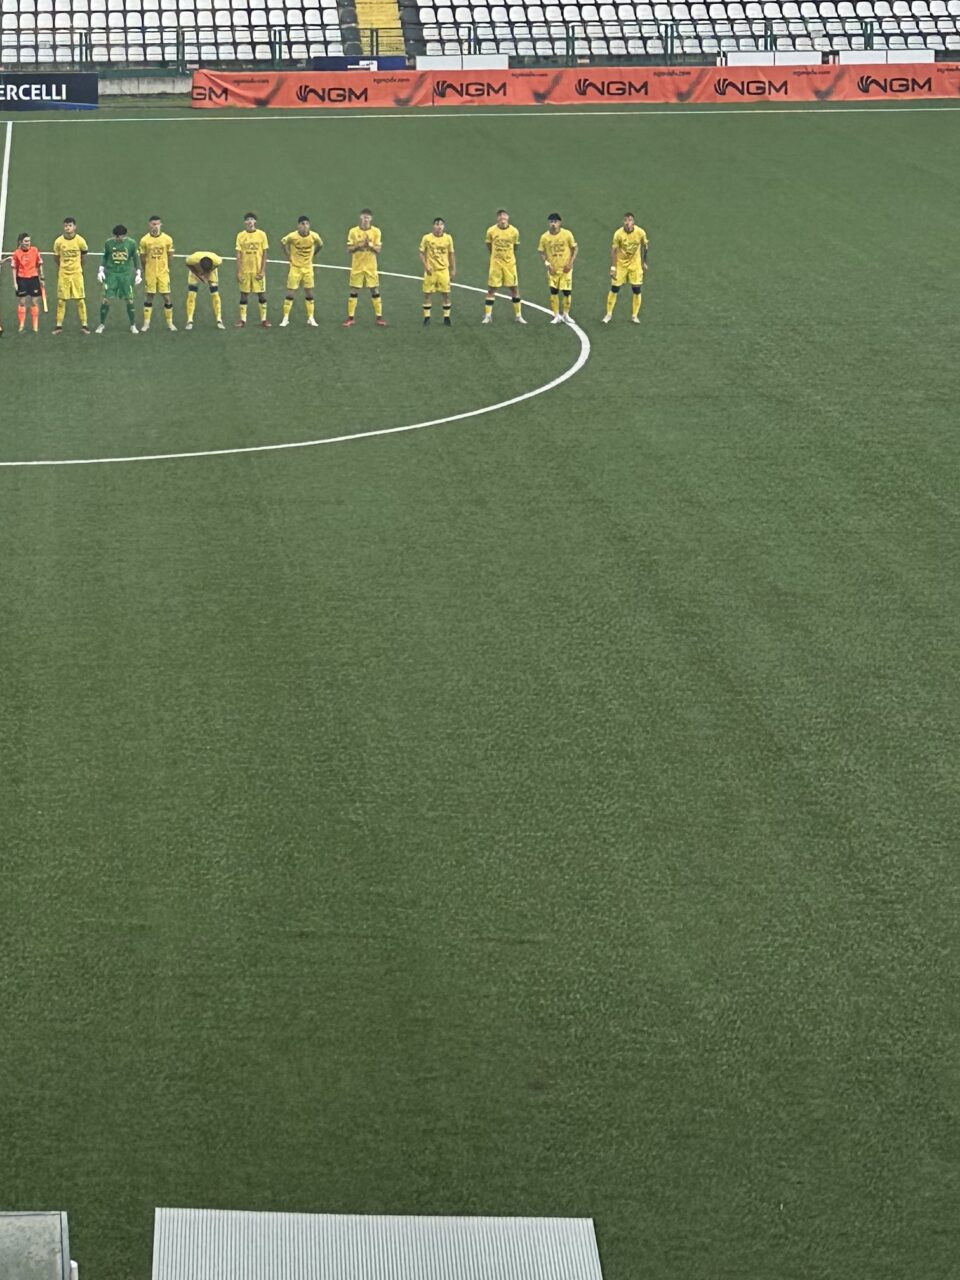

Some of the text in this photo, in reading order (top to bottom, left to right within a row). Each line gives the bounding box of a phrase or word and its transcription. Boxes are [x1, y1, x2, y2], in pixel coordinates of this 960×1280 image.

[296, 84, 368, 102] NGM
[433, 80, 507, 97] NGM
[575, 78, 649, 96] NGM
[714, 77, 788, 96] NGM
[857, 75, 933, 94] NGM
